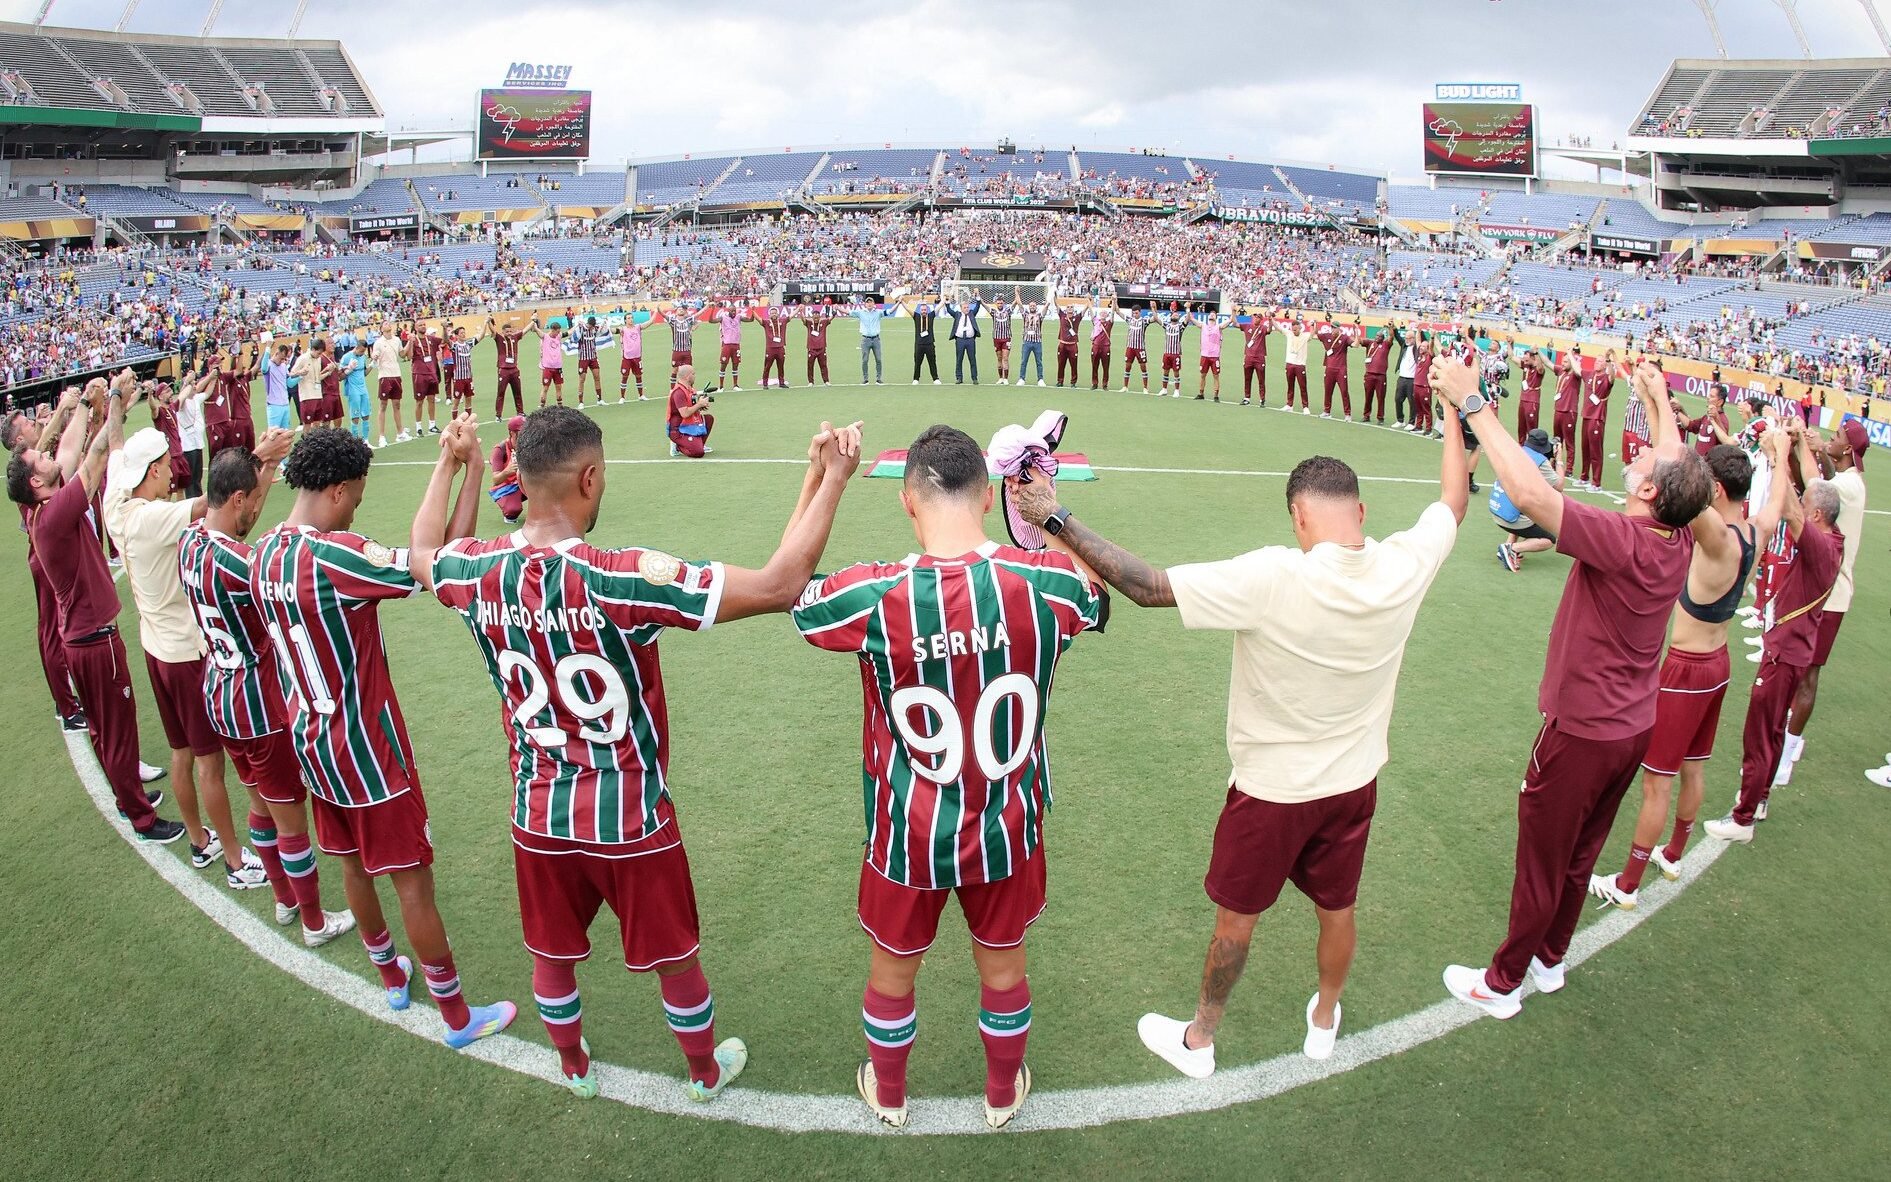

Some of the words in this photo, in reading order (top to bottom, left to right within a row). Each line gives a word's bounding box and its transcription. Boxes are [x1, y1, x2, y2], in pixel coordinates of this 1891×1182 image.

[505, 62, 573, 80] MASSEY
[1437, 84, 1471, 100] BUD
[1472, 84, 1519, 100] LIGHT
[359, 220, 373, 229] Take
[386, 218, 396, 227] The
[396, 217, 413, 226] World
[1481, 227, 1502, 237] NEW
[1502, 228, 1526, 238] YORK
[1597, 237, 1610, 246] Take
[1623, 240, 1634, 248] The
[1635, 241, 1651, 250] World
[800, 283, 817, 292] Take
[826, 283, 834, 292] To
[836, 283, 850, 292] The
[851, 282, 874, 292] World
[1685, 376, 1730, 403] QATR
[259, 580, 294, 602] KENO
[533, 606, 606, 633] SANTOS
[911, 620, 1011, 663] SERNA
[268, 621, 336, 715] 11
[497, 649, 630, 747] 29
[889, 671, 1039, 786] 90
